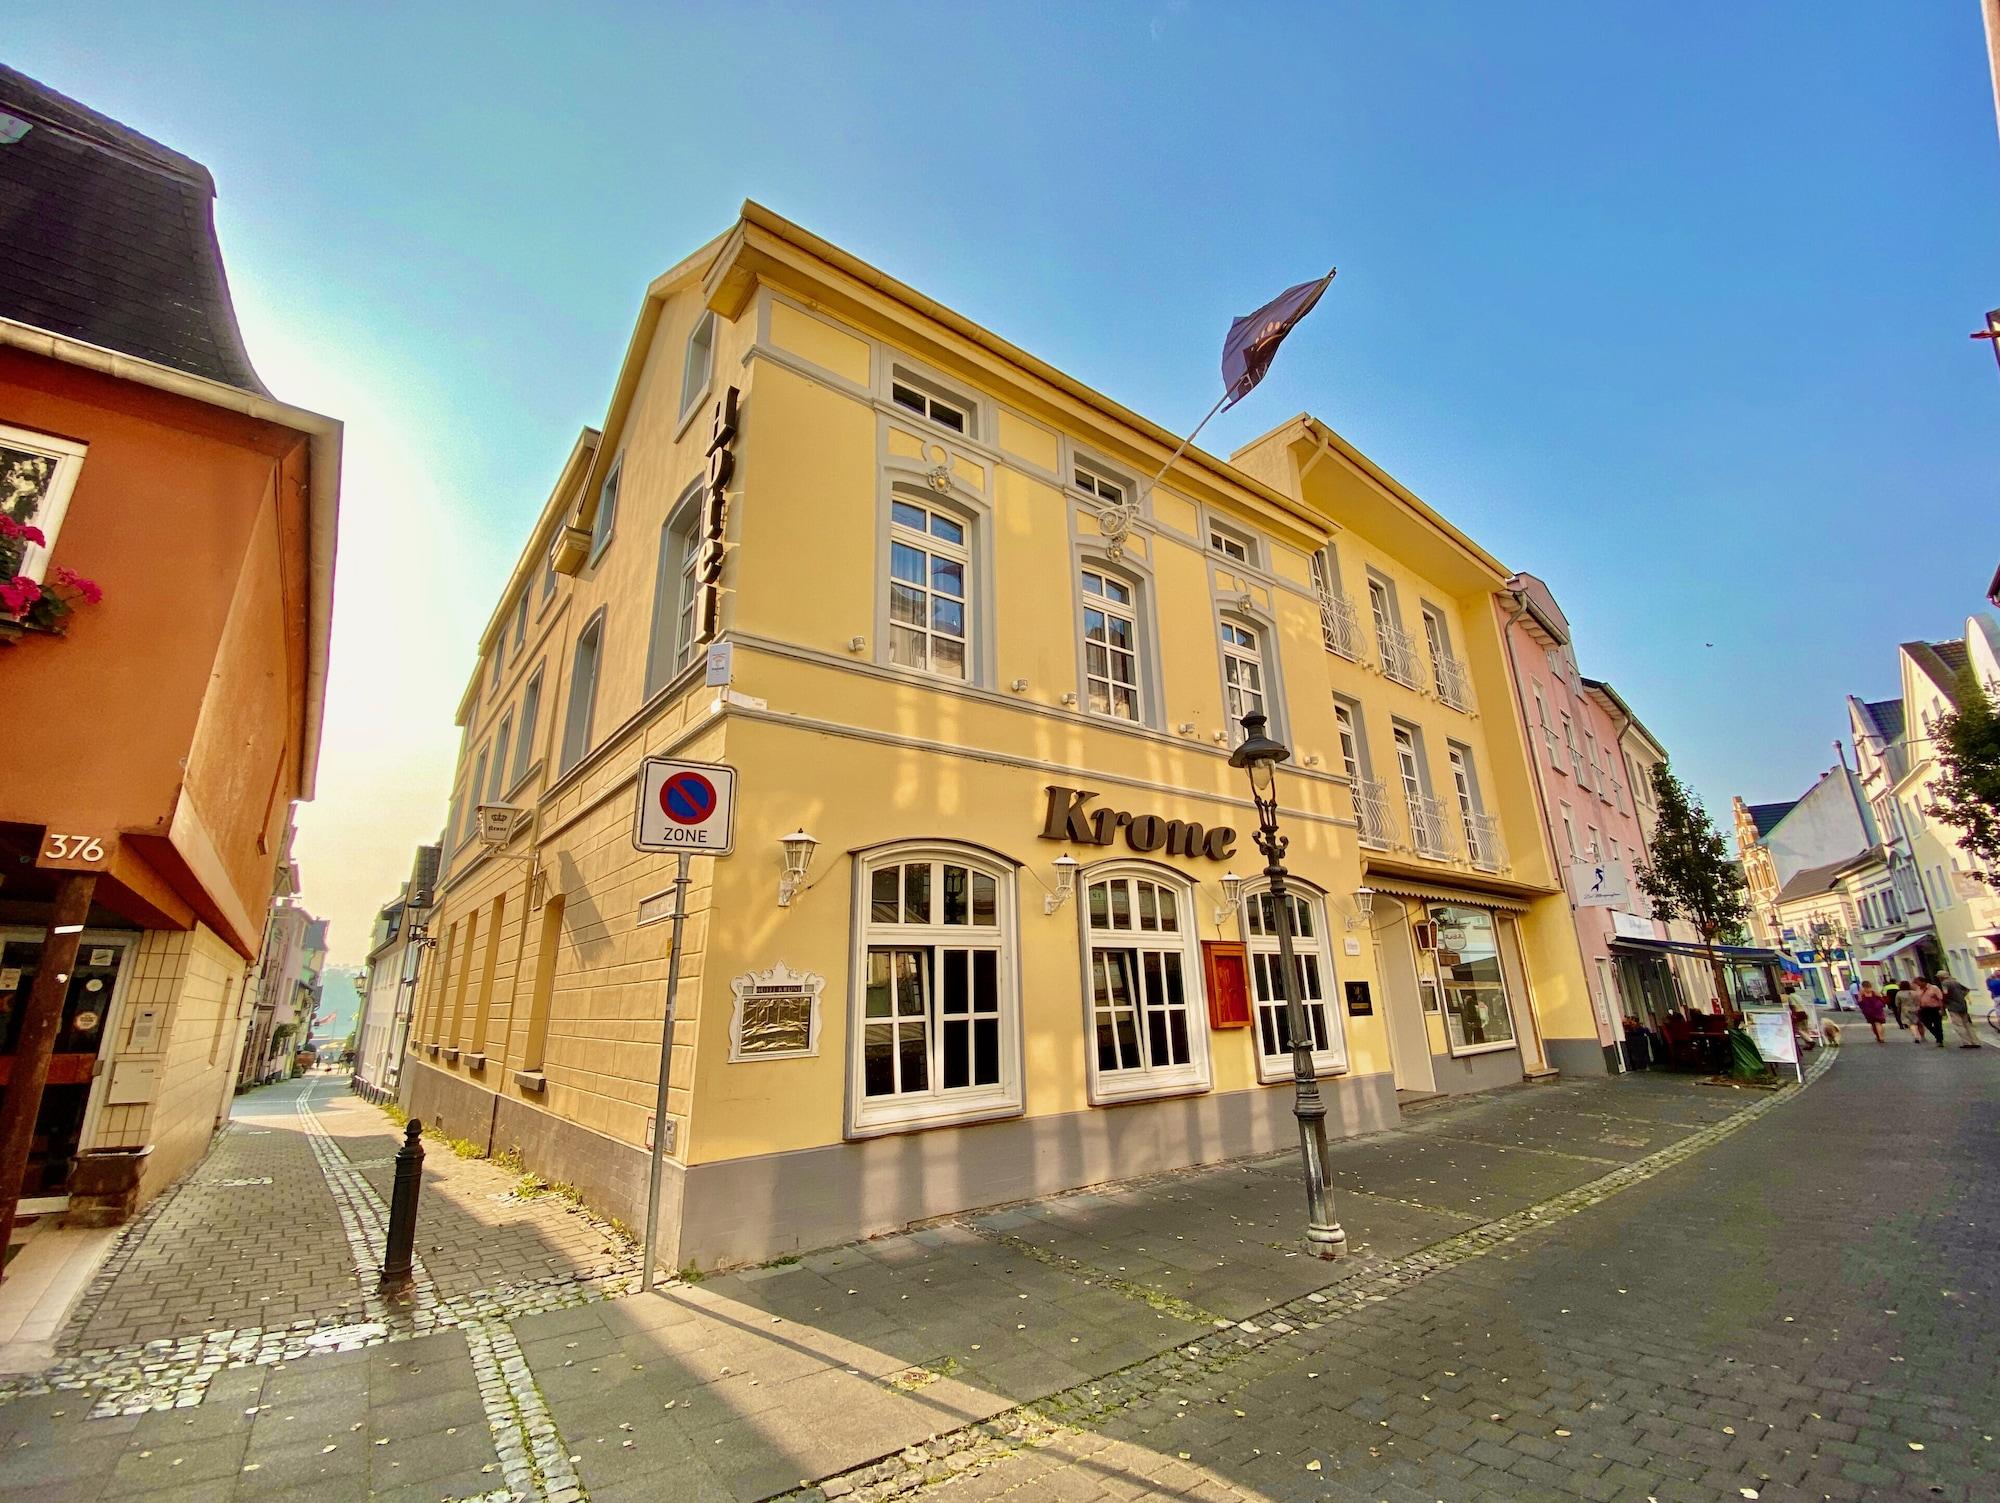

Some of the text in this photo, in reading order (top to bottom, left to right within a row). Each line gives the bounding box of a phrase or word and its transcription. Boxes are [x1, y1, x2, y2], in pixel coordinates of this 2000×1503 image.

[694, 385, 740, 645] Hotel
[45, 834, 105, 862] 376
[663, 827, 708, 843] ZONE
[1038, 784, 1238, 861] Krone
